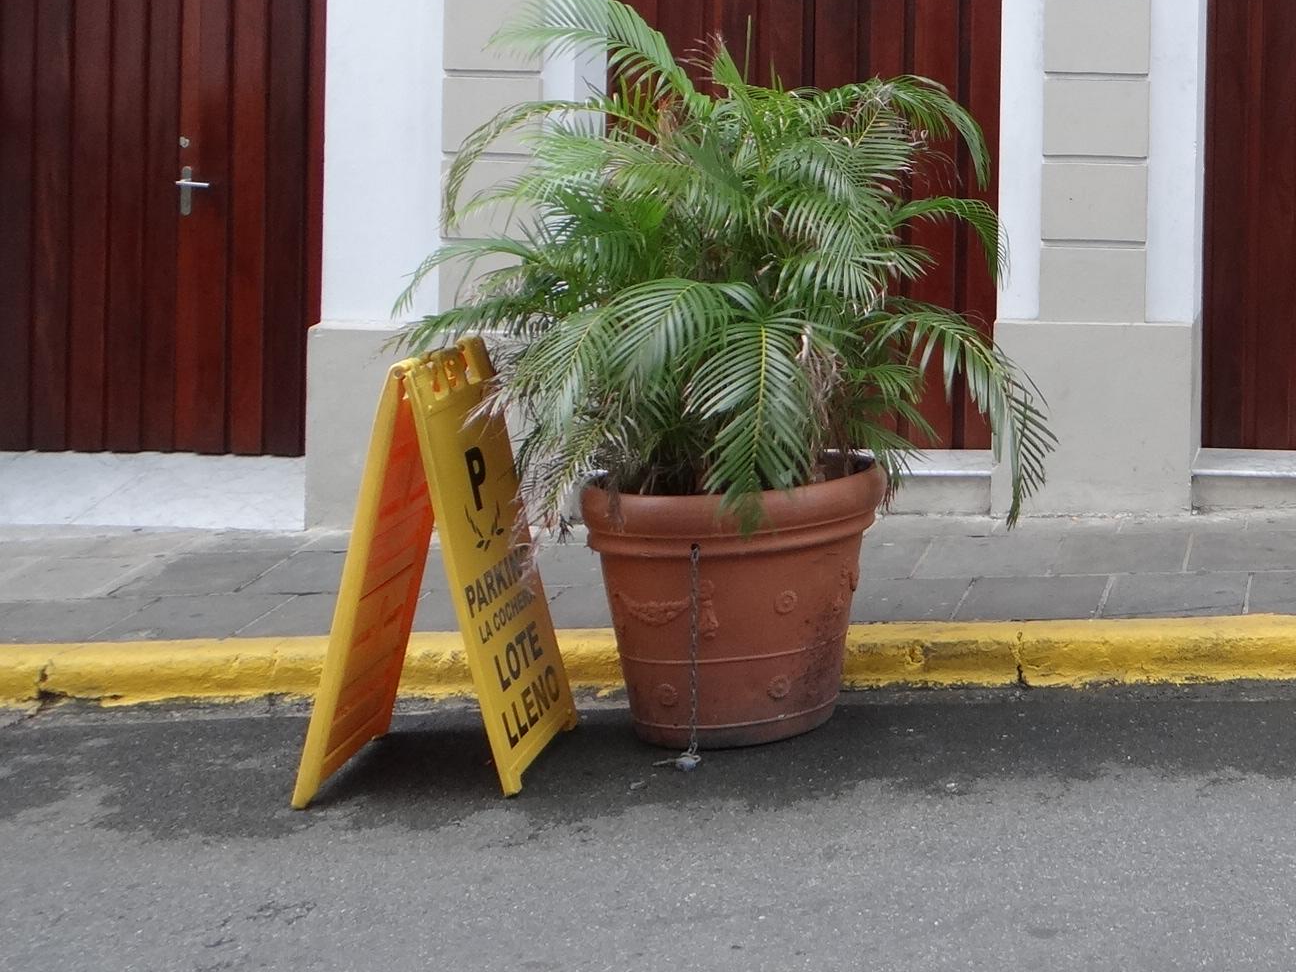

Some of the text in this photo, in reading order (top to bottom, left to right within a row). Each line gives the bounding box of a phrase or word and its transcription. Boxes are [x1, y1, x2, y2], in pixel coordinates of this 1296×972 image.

[464, 446, 486, 511] P
[478, 620, 494, 644] LA
[494, 621, 543, 692] LOTE
[501, 664, 560, 750] LLENO
